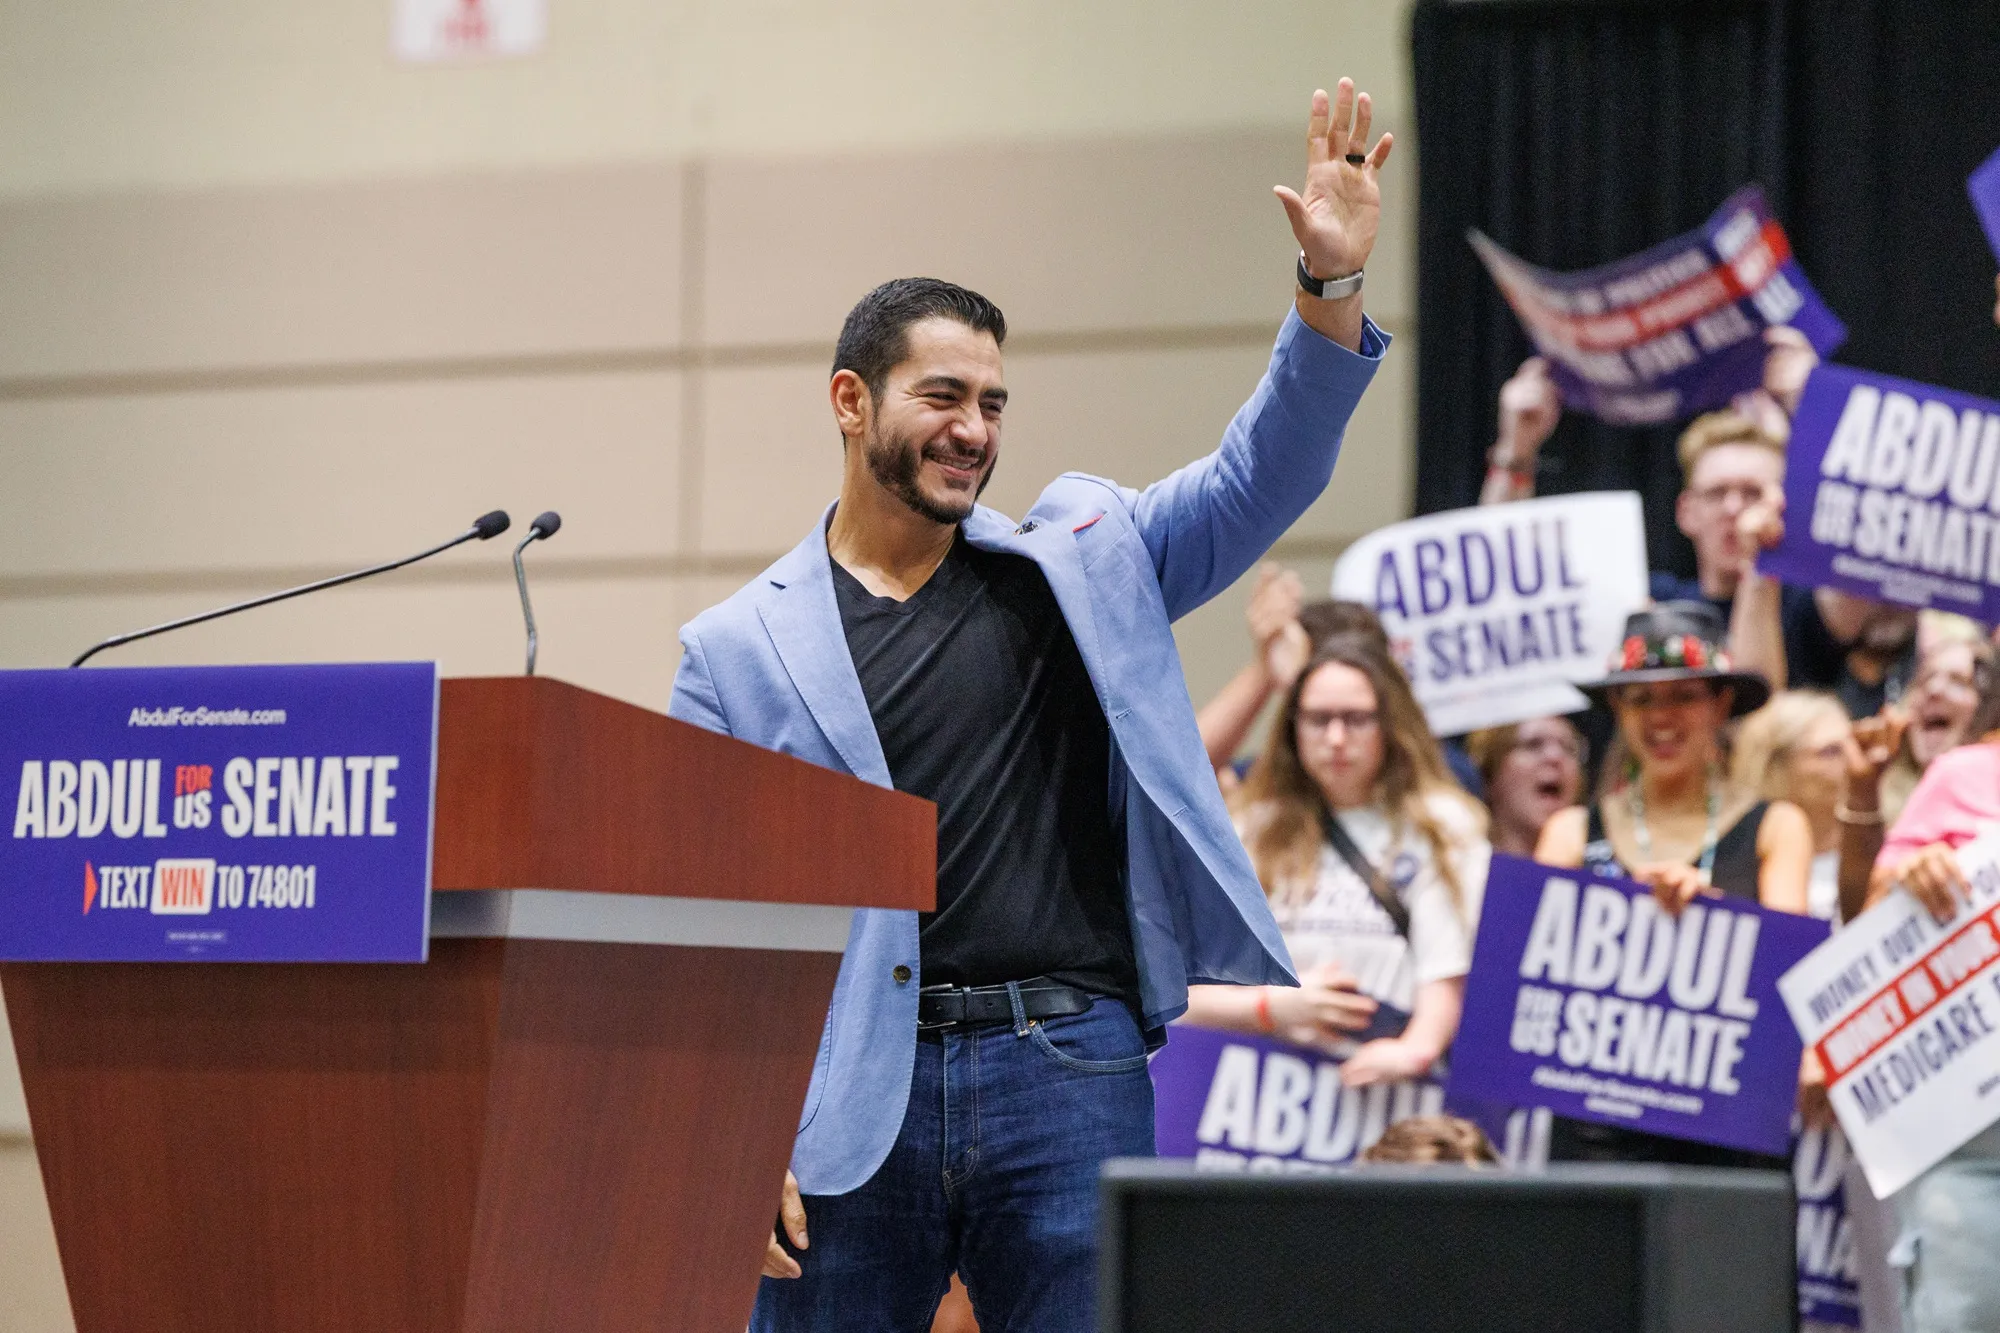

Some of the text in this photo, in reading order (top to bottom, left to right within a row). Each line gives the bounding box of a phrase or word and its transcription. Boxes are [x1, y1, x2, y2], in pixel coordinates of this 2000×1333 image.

[1820, 383, 2000, 516] ABDU
[1377, 519, 1585, 619] ABDUL
[1426, 602, 1592, 684] SENATE
[128, 706, 287, 727] AbdulForSenate.com
[13, 756, 400, 838] ABDUL FOR US SENATE
[99, 864, 317, 909] TEXT WIN TO 74801
[1518, 876, 1762, 1021] ABDUL
[1556, 990, 1751, 1096] SENATE
[1850, 990, 1995, 1126] MEDICARE
